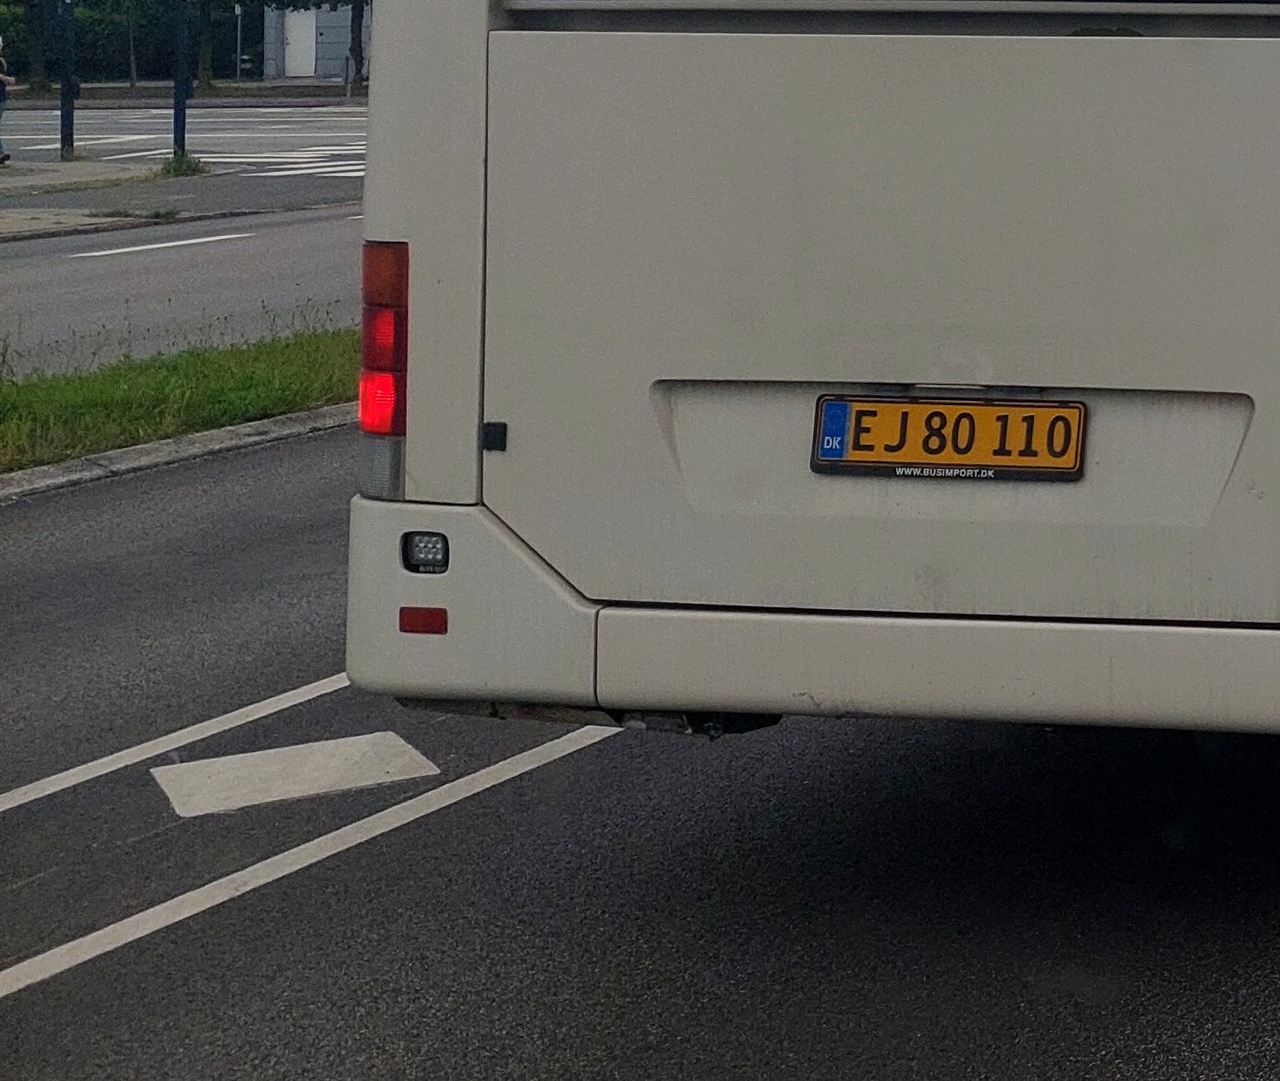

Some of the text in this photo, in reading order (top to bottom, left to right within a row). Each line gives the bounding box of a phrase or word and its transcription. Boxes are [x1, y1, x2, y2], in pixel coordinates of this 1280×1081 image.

[824, 409, 1072, 458] DK EJ 80 110
[895, 467, 995, 479] WWW.BUSIMPORT.DK
